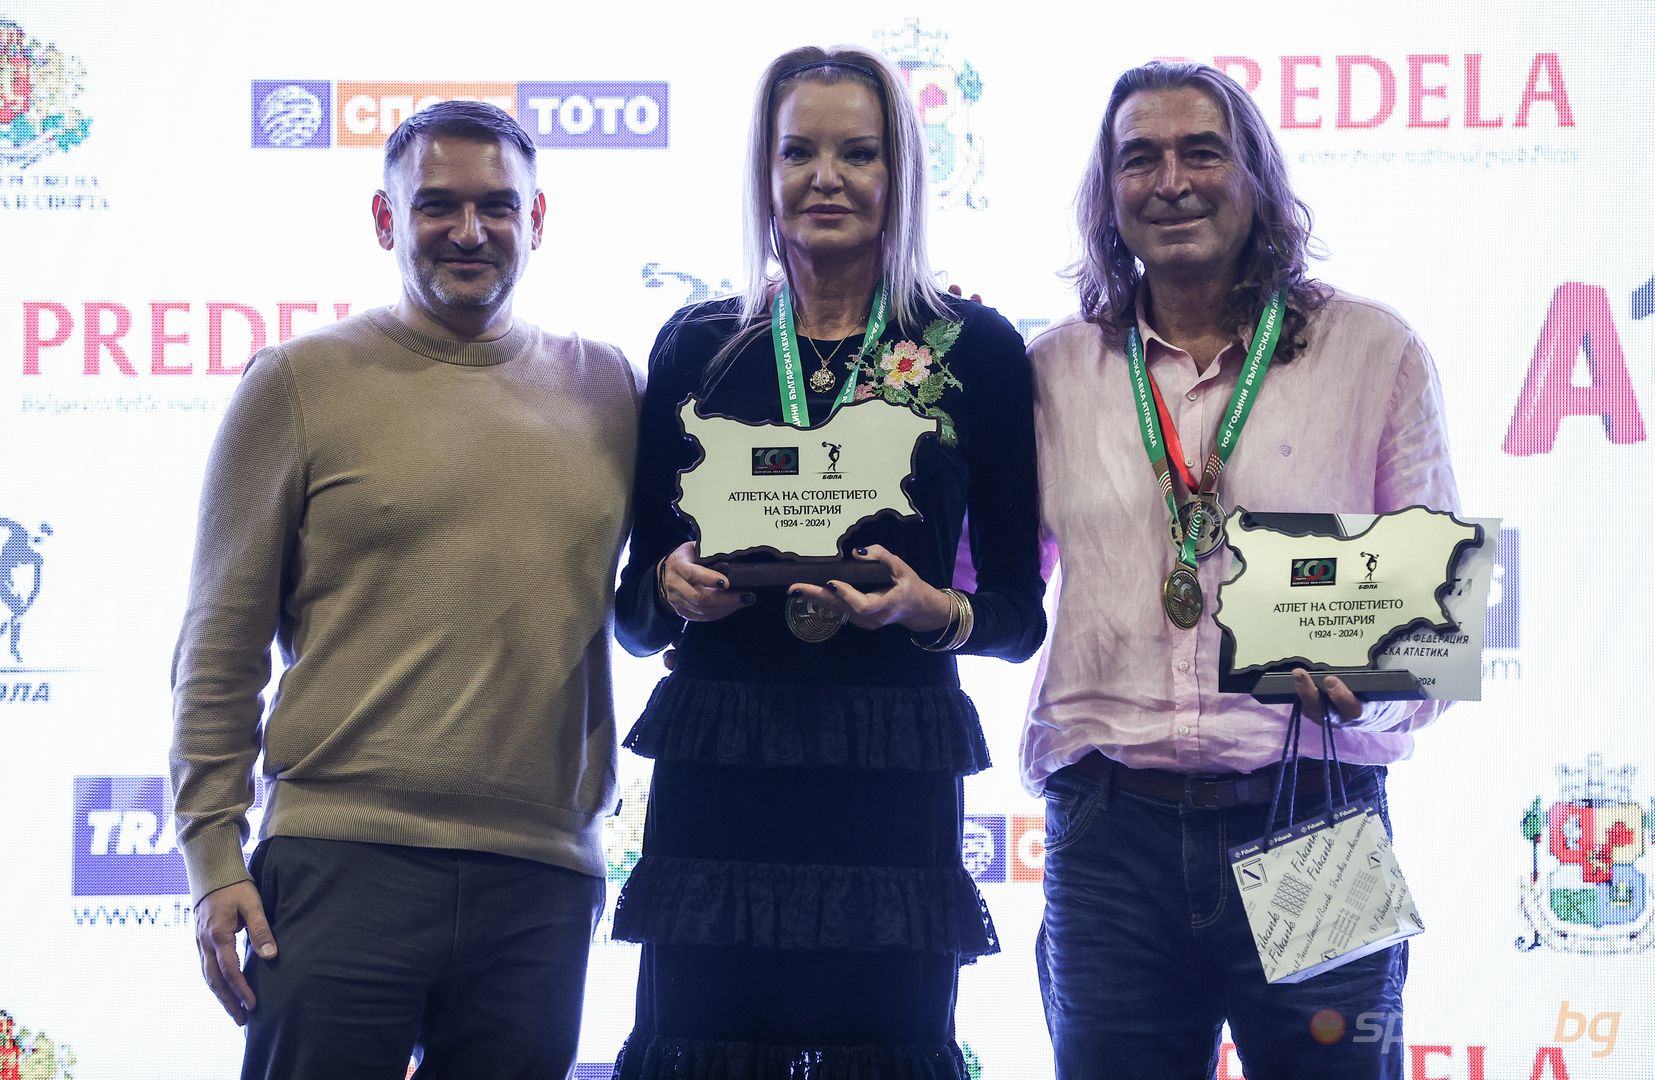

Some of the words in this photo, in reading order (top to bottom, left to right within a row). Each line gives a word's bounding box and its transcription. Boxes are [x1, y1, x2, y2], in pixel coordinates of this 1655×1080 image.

[1153, 52, 1576, 129] EDELA
[528, 95, 660, 135] ТОТО
[781, 331, 790, 354] ЛЕКА
[784, 353, 797, 400] БЪЛГАРСКА
[1221, 430, 1233, 448] 100
[1228, 389, 1249, 430] ГОДИНИ
[1245, 331, 1272, 387] БЪЛГАРСКА
[1266, 308, 1279, 334] ЛЕКА
[1137, 376, 1147, 402] ЛЕКА
[1142, 400, 1157, 448] АТЛЕТИКА
[728, 491, 780, 502] АТЛЕТКА
[782, 491, 800, 501] НА
[801, 489, 877, 501] СТОЛЕТИЕТО
[764, 505, 781, 516] НА
[783, 504, 842, 516] БЪЛГАРИЯ
[1273, 602, 1308, 613] АТЛЕТ
[1310, 602, 1327, 612] НА
[1328, 599, 1404, 612] СТОЛЕТИЕТО
[1299, 617, 1316, 627] НА
[1318, 615, 1376, 626] БЪЛГАРИЯ
[1383, 646, 1401, 656] ЕКА
[1403, 647, 1449, 657] АТЛЕТИКА
[1413, 634, 1470, 645] ФЕДЕРАЦИЯ
[1307, 836, 1335, 882] Fibank
[1268, 919, 1296, 965] Fibank
